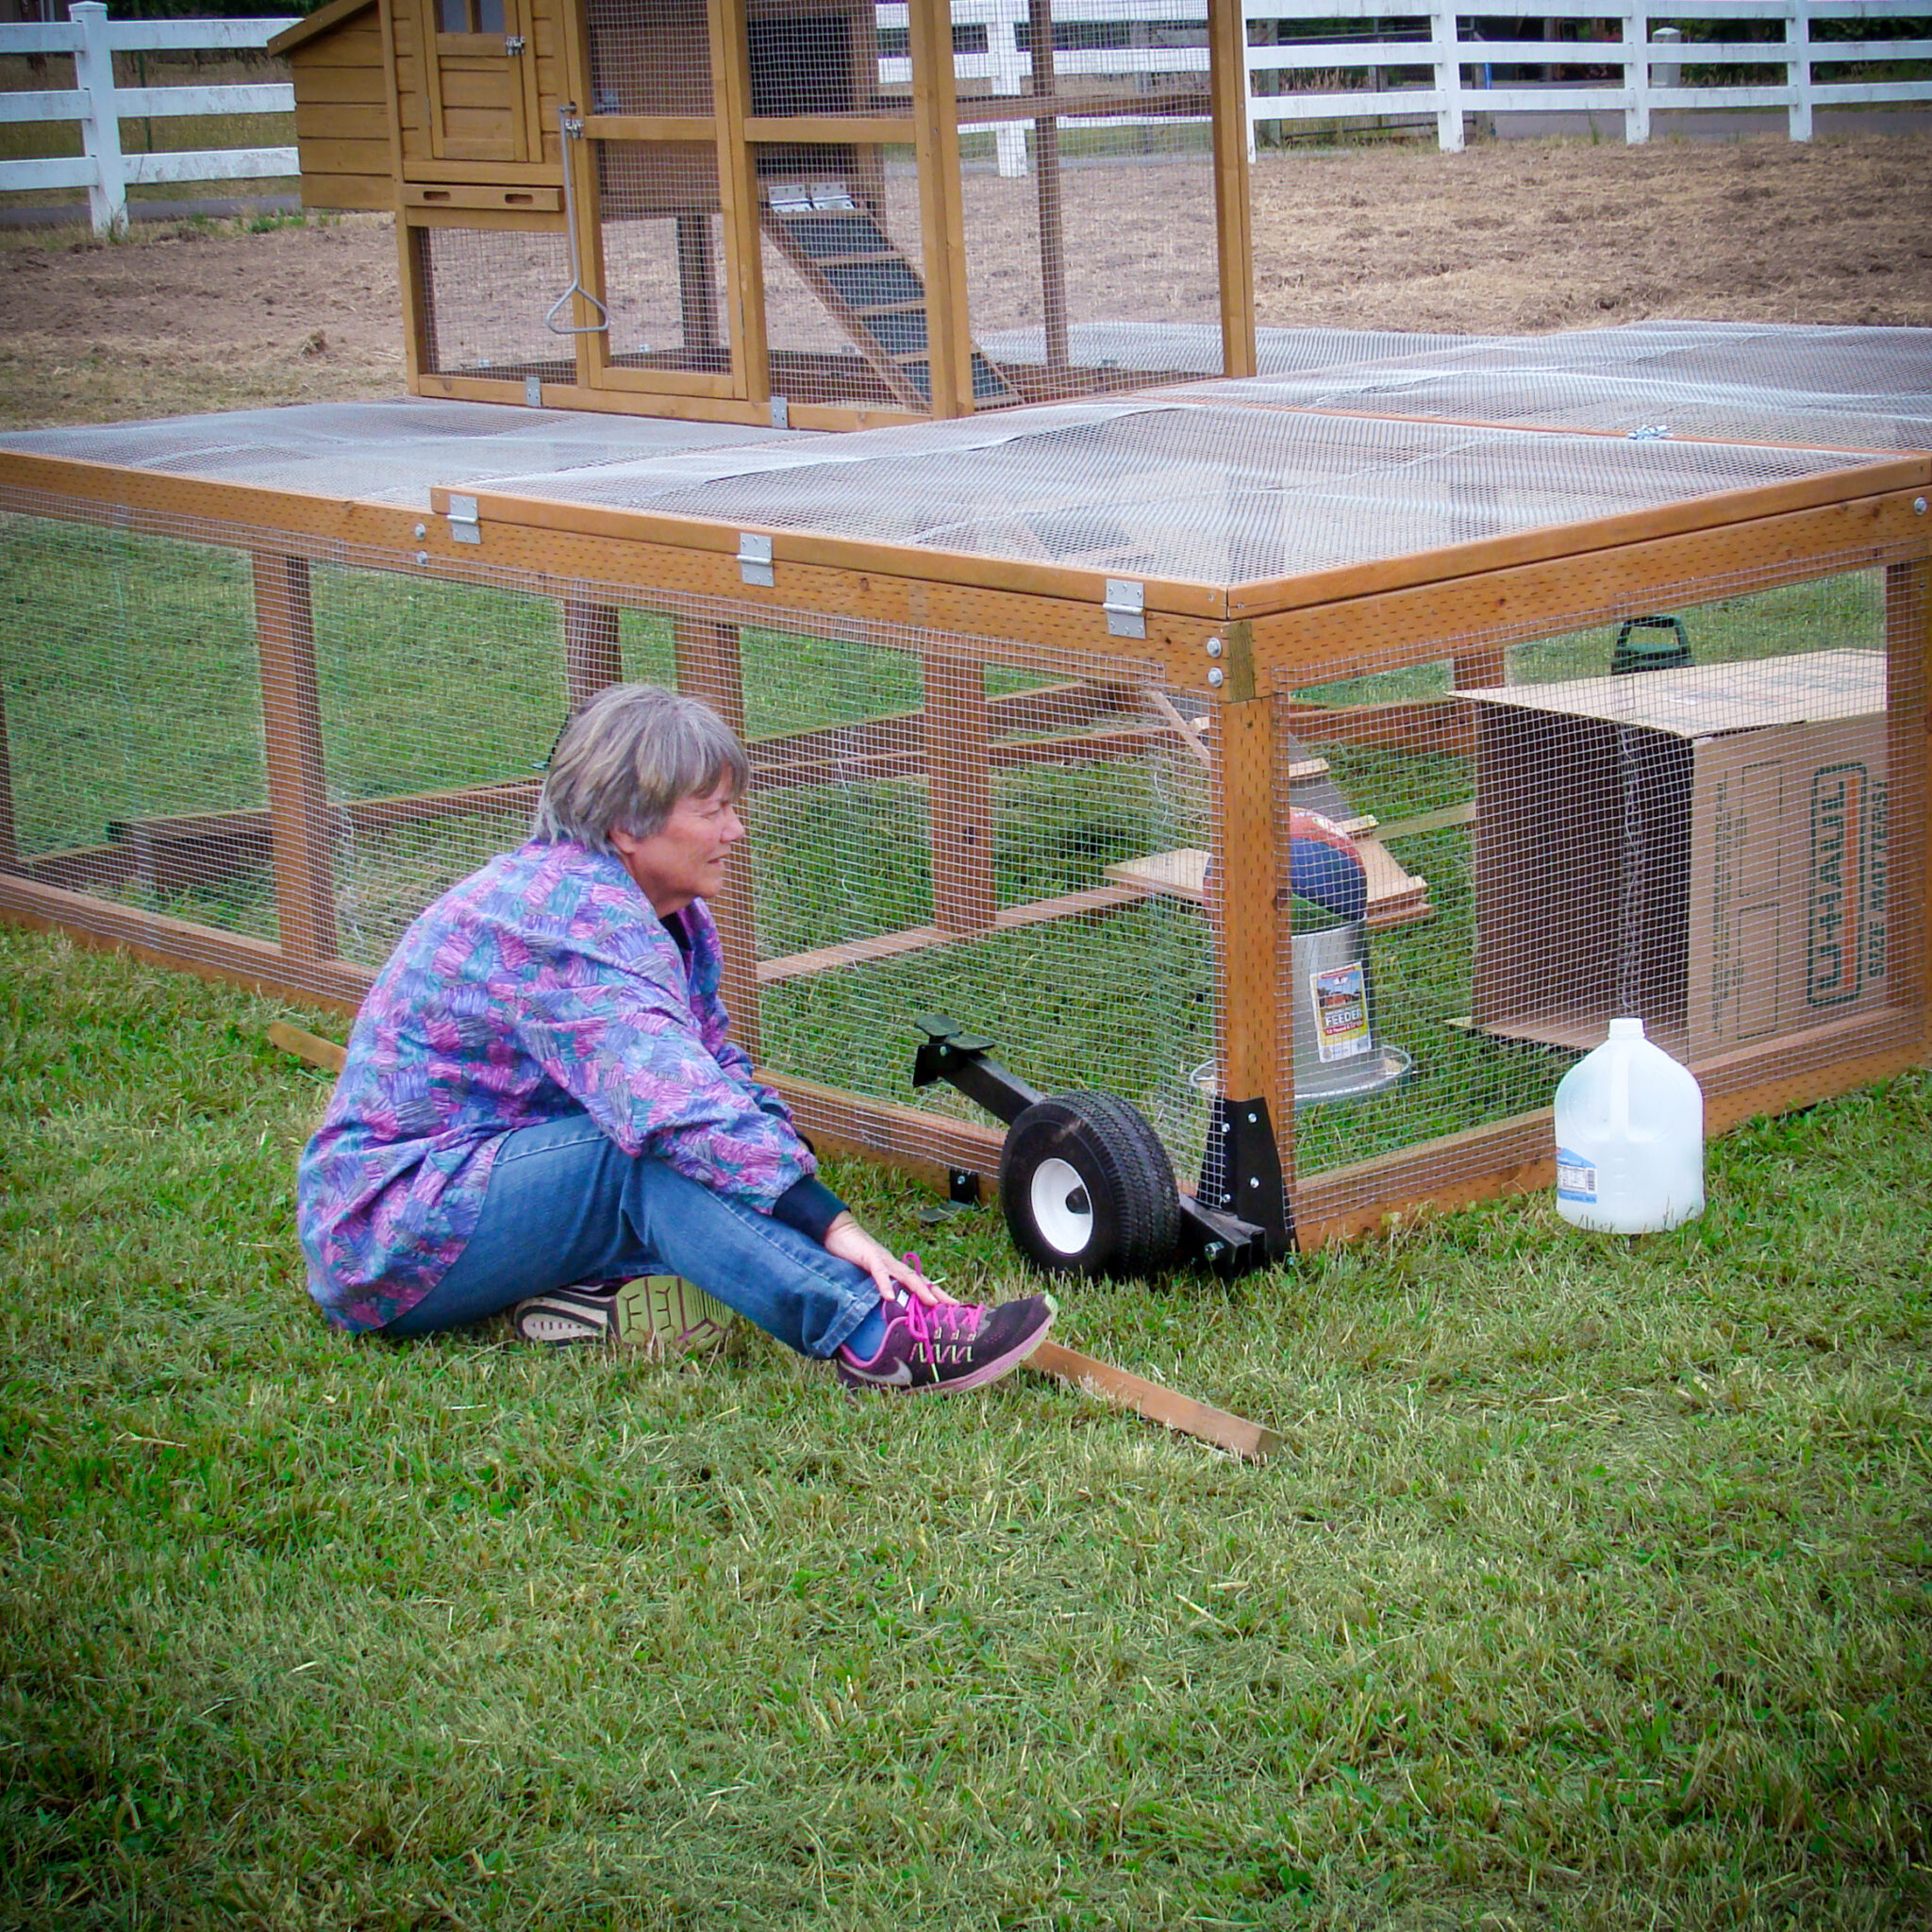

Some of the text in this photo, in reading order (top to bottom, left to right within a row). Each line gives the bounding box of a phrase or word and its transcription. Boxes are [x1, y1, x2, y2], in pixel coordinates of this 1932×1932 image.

[1820, 781, 1843, 989] U-HAUL
[1868, 921, 1885, 977] SIZE
[1325, 1008, 1362, 1026] FEEDER
